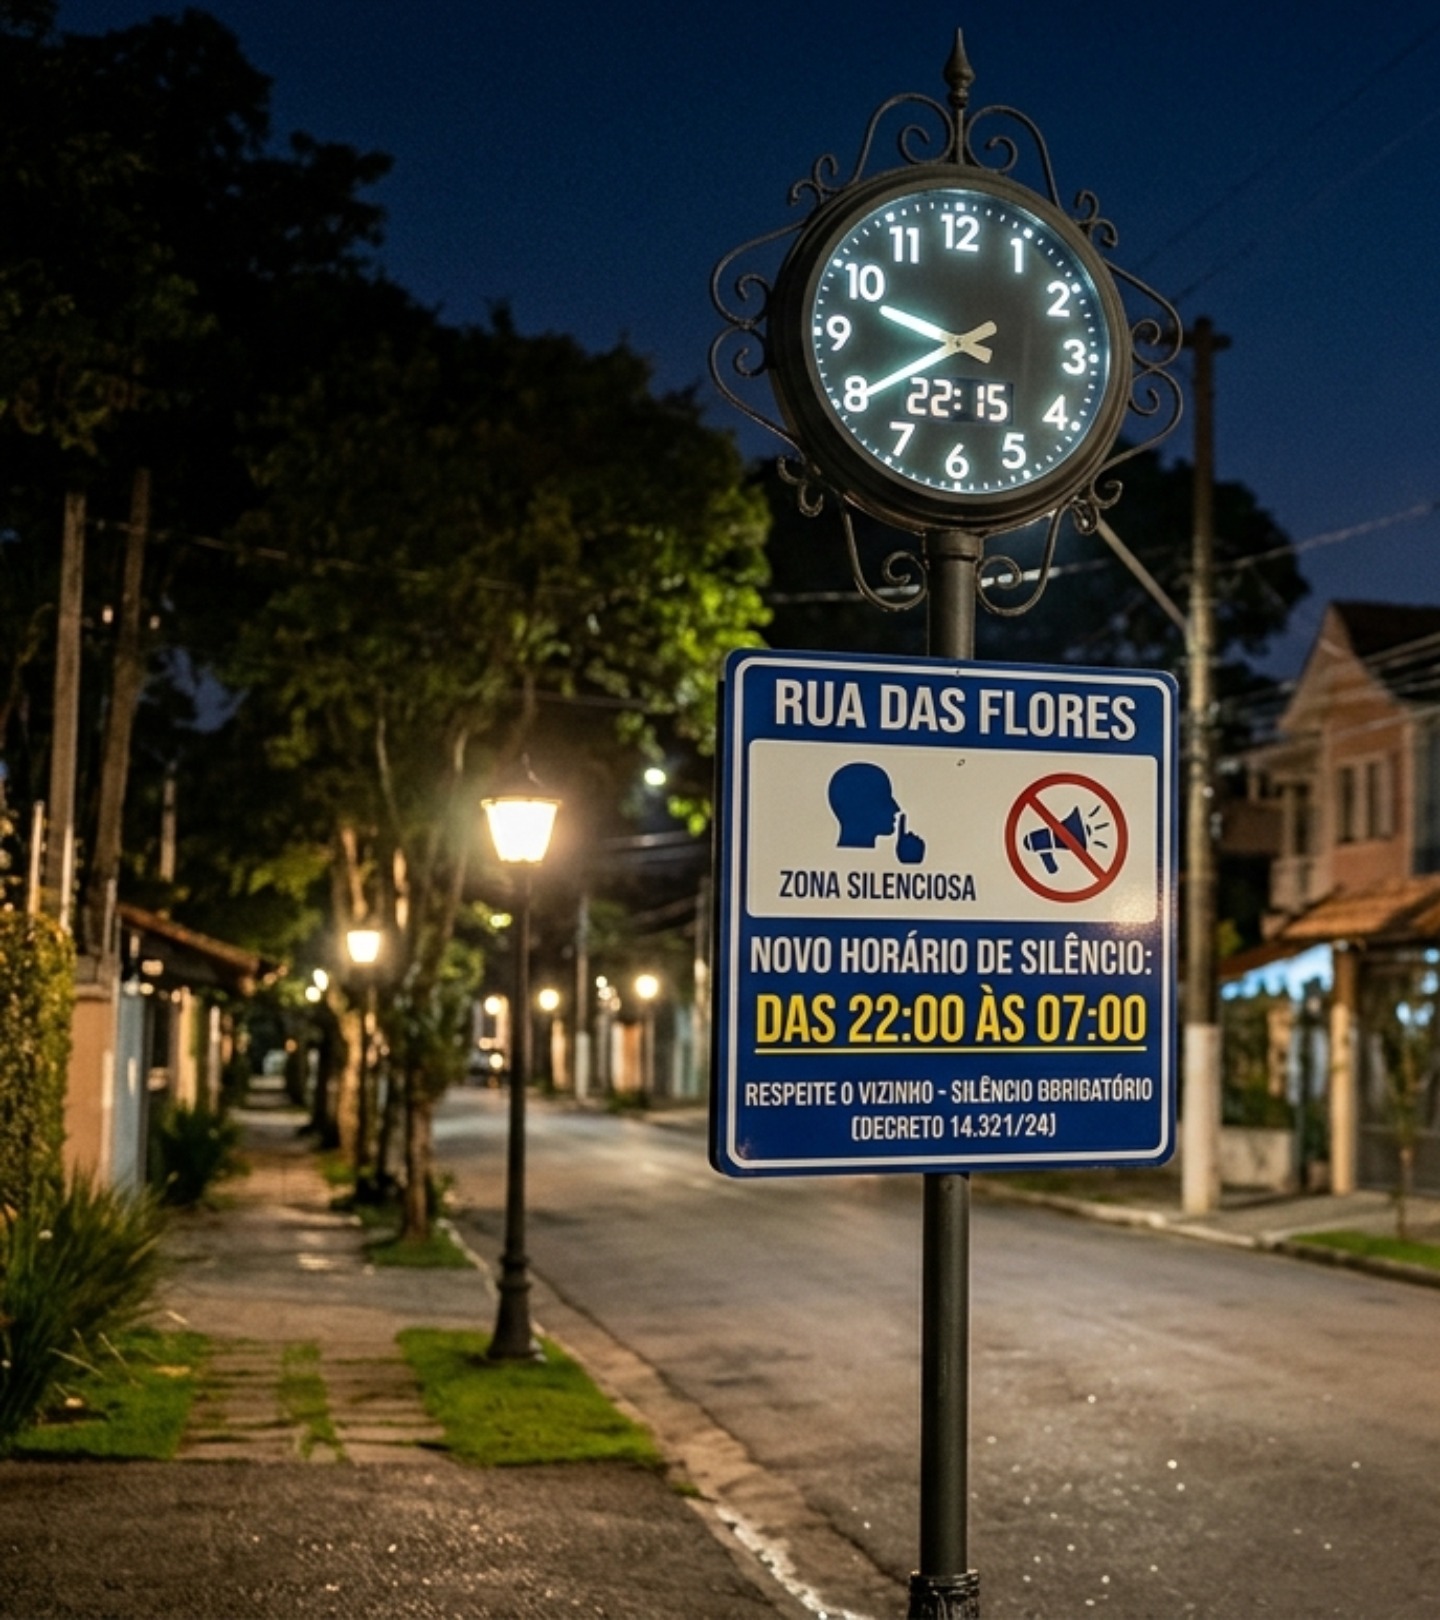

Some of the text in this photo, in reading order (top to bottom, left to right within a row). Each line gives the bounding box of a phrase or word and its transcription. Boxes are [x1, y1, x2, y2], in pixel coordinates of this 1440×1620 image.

[889, 225, 920, 263] 11
[940, 213, 980, 252] 12
[1010, 237, 1024, 274] 1
[845, 262, 885, 302] 10
[1047, 281, 1071, 318] 2
[826, 315, 852, 351] 9
[1062, 339, 1087, 375] 3
[843, 375, 869, 413] 8
[906, 376, 1008, 422] 22:15
[1042, 394, 1069, 431] 4
[889, 421, 915, 457] 7
[1002, 432, 1027, 469] 5
[945, 443, 970, 480] 6
[775, 678, 1137, 741] RUA DAS FLORES
[779, 870, 977, 901] ZONA SILENCIOSA
[750, 929, 1152, 976] NOVO HORÁRIO DE SILÊNCIO:
[756, 983, 1147, 1043] DAS 22:00 ÀS 07:00
[745, 1081, 837, 1107] RESPEITE
[840, 1081, 854, 1107] O
[858, 1079, 934, 1106] VIZINHO
[950, 1075, 1034, 1105] SILÊNCIO
